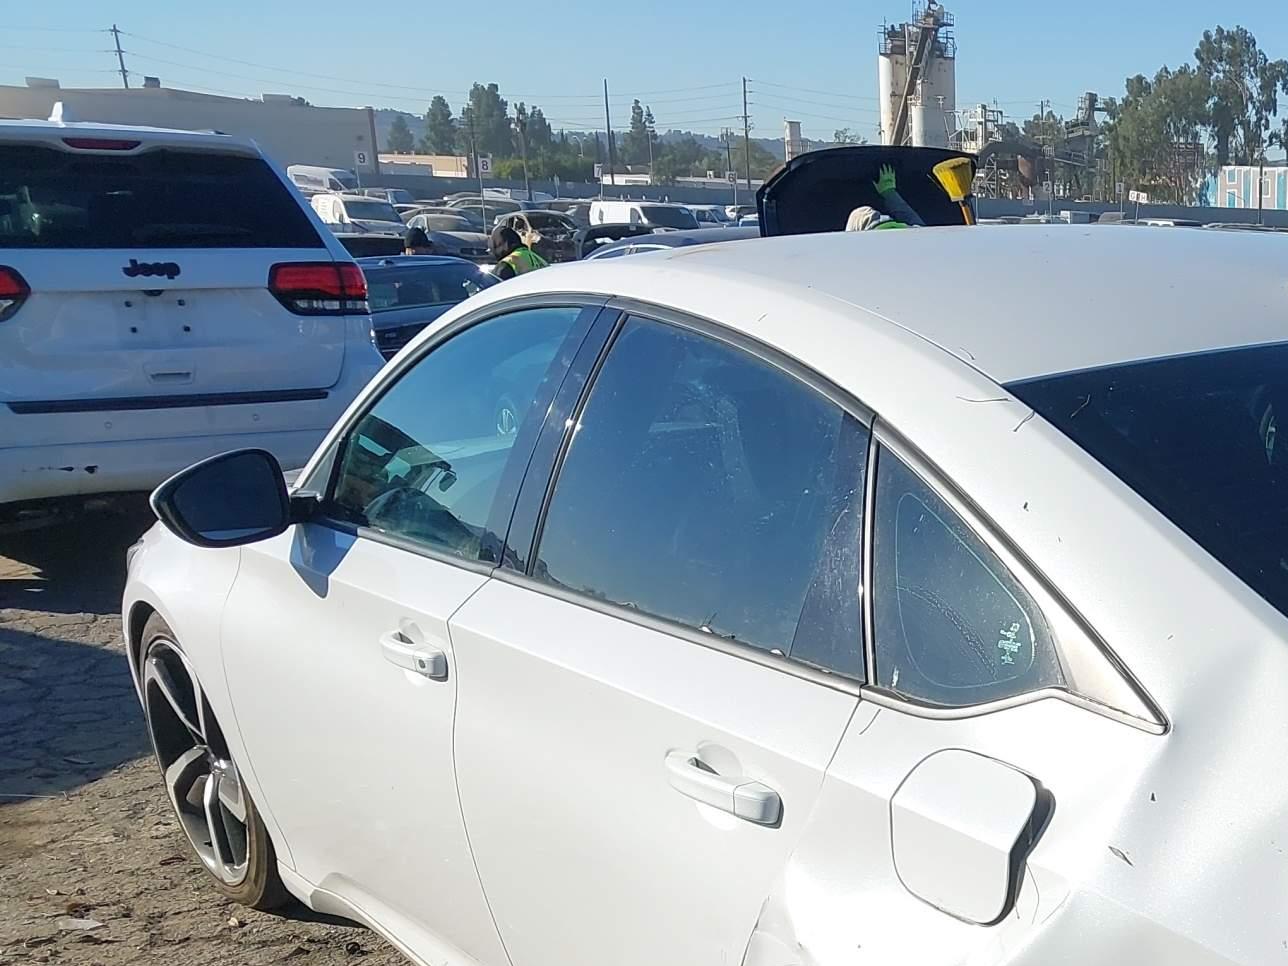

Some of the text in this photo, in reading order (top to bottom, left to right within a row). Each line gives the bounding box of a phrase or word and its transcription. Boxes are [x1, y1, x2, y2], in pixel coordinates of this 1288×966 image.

[357, 152, 366, 164] 9
[481, 160, 489, 171] 8
[595, 165, 602, 176] 7
[122, 258, 181, 280] Jeep
